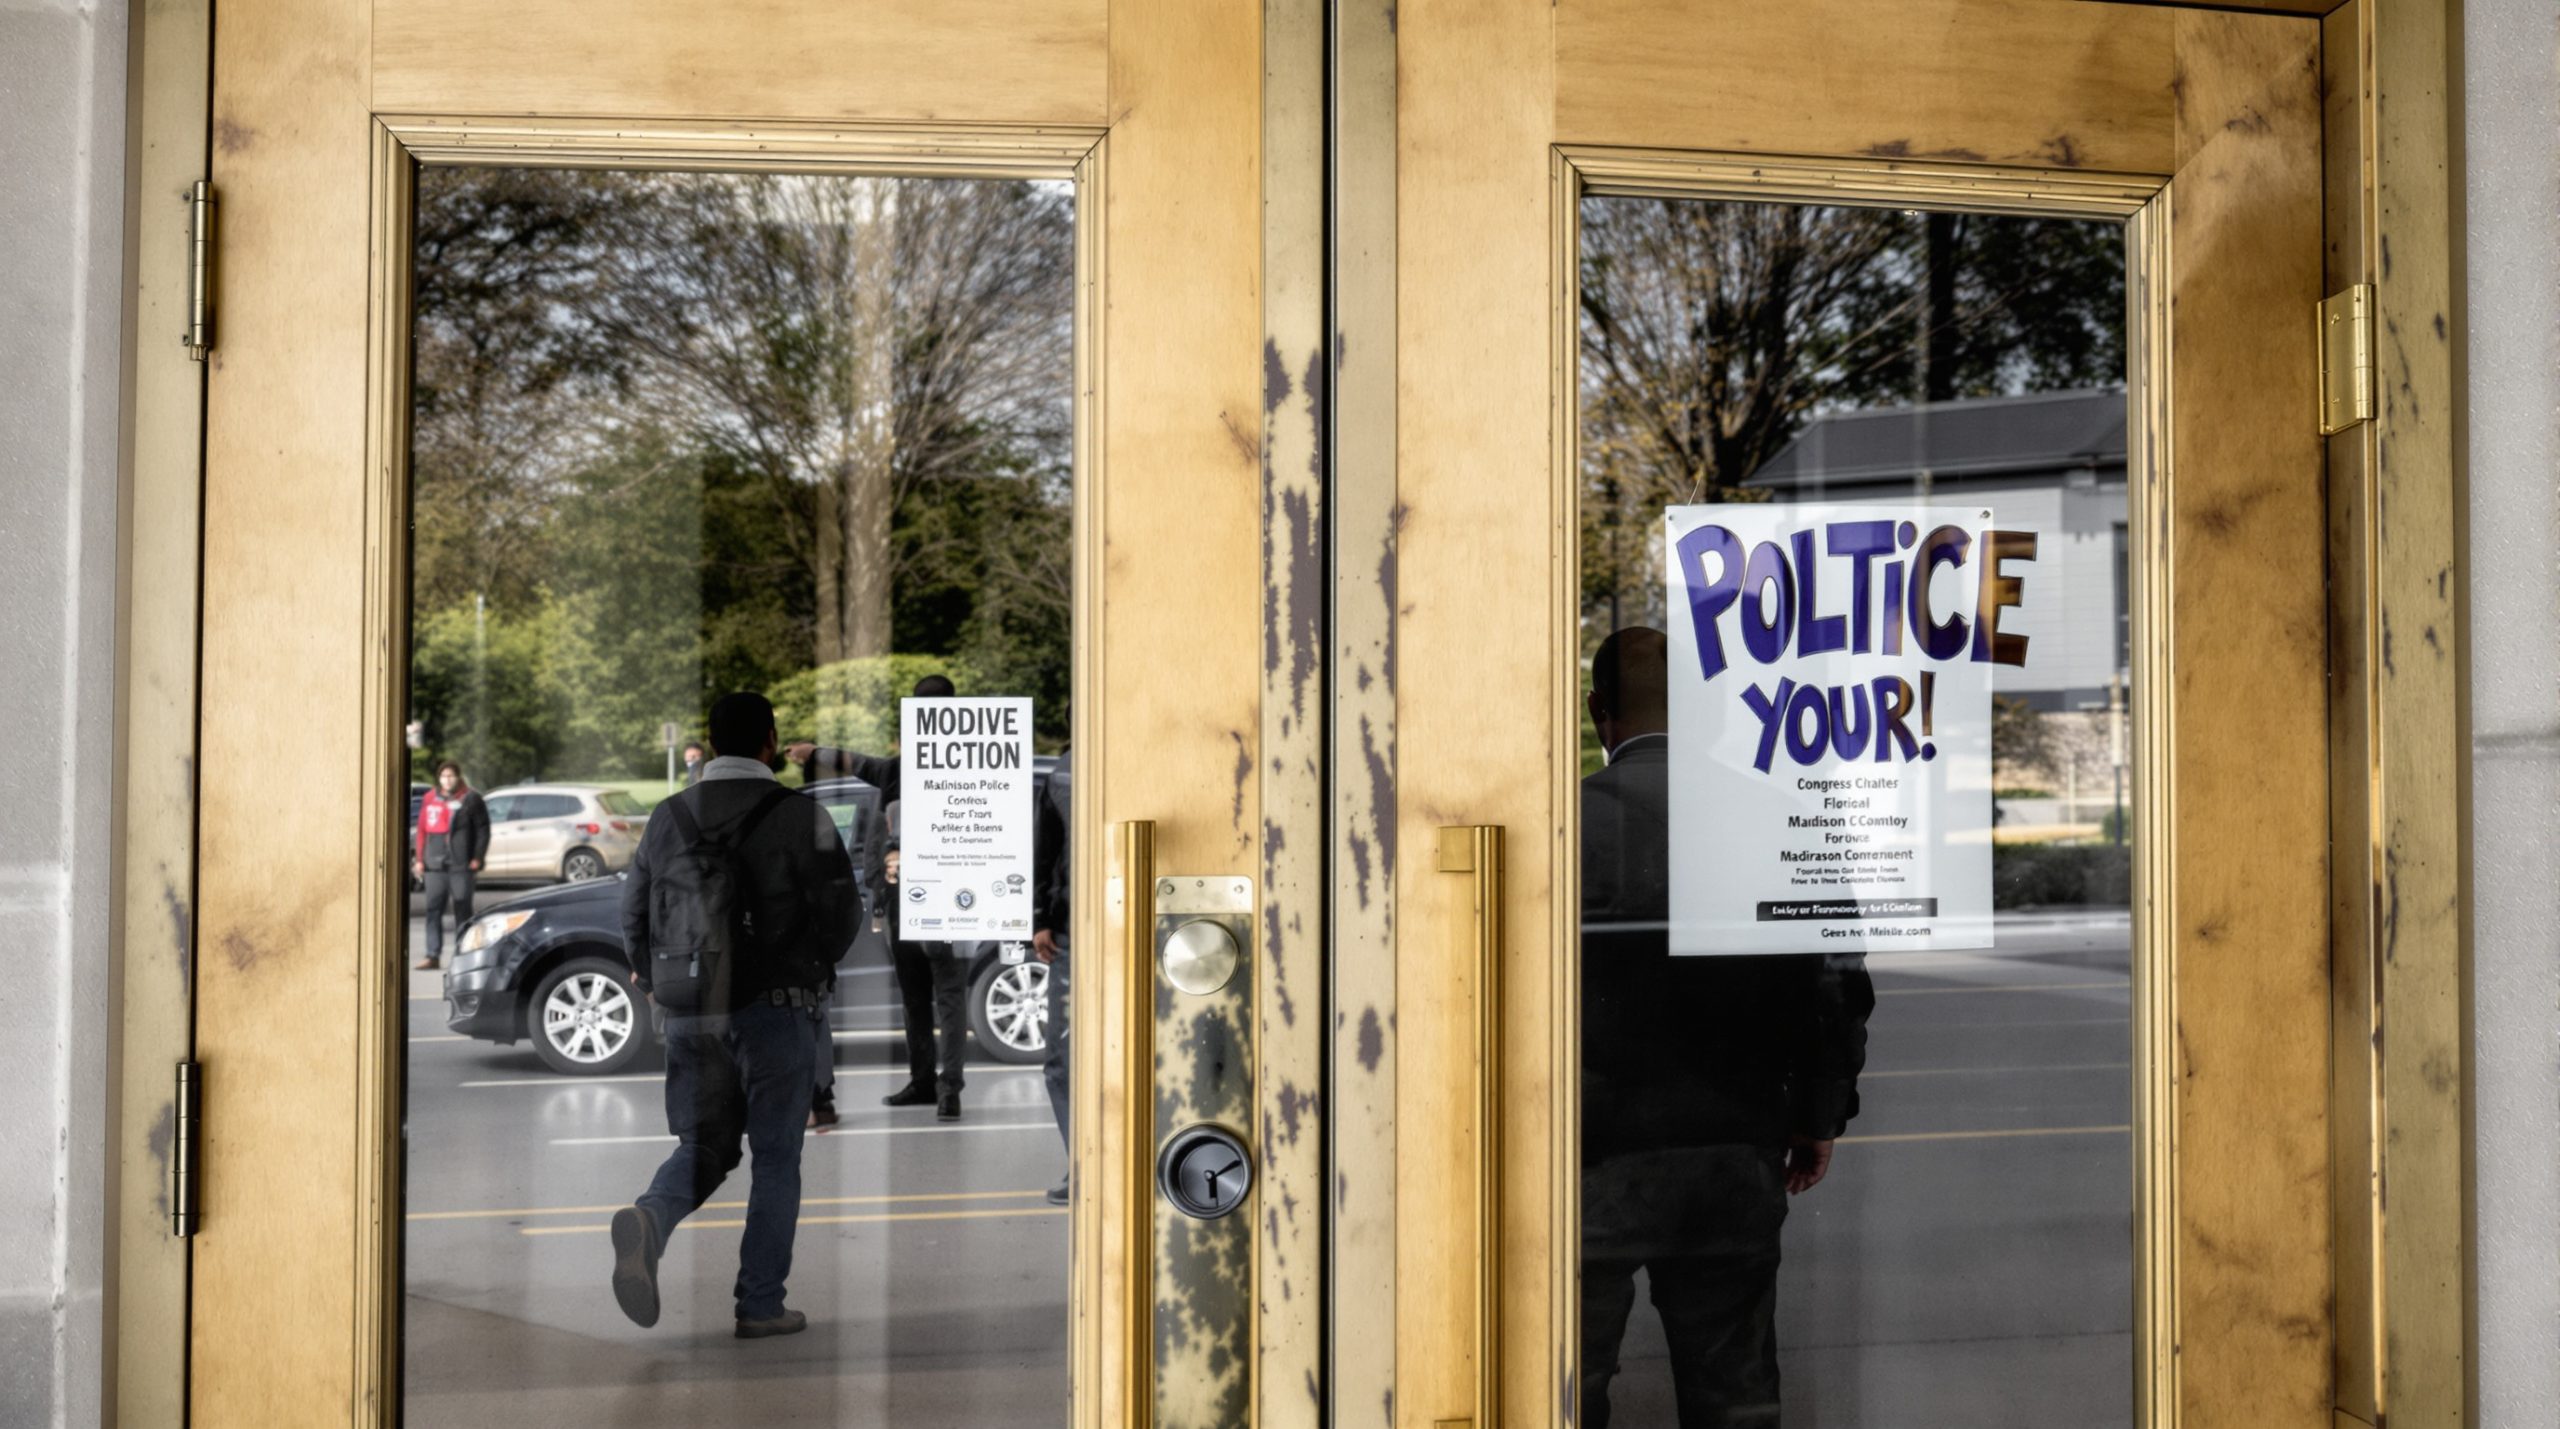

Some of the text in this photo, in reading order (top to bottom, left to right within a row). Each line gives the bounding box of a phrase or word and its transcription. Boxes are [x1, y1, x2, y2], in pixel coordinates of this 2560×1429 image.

[916, 707, 1018, 735] MODIVE
[1739, 670, 1937, 774] YOUR!
[916, 741, 1020, 769] ELCTION
[979, 780, 1010, 790] Police
[1797, 778, 1851, 792] Congress
